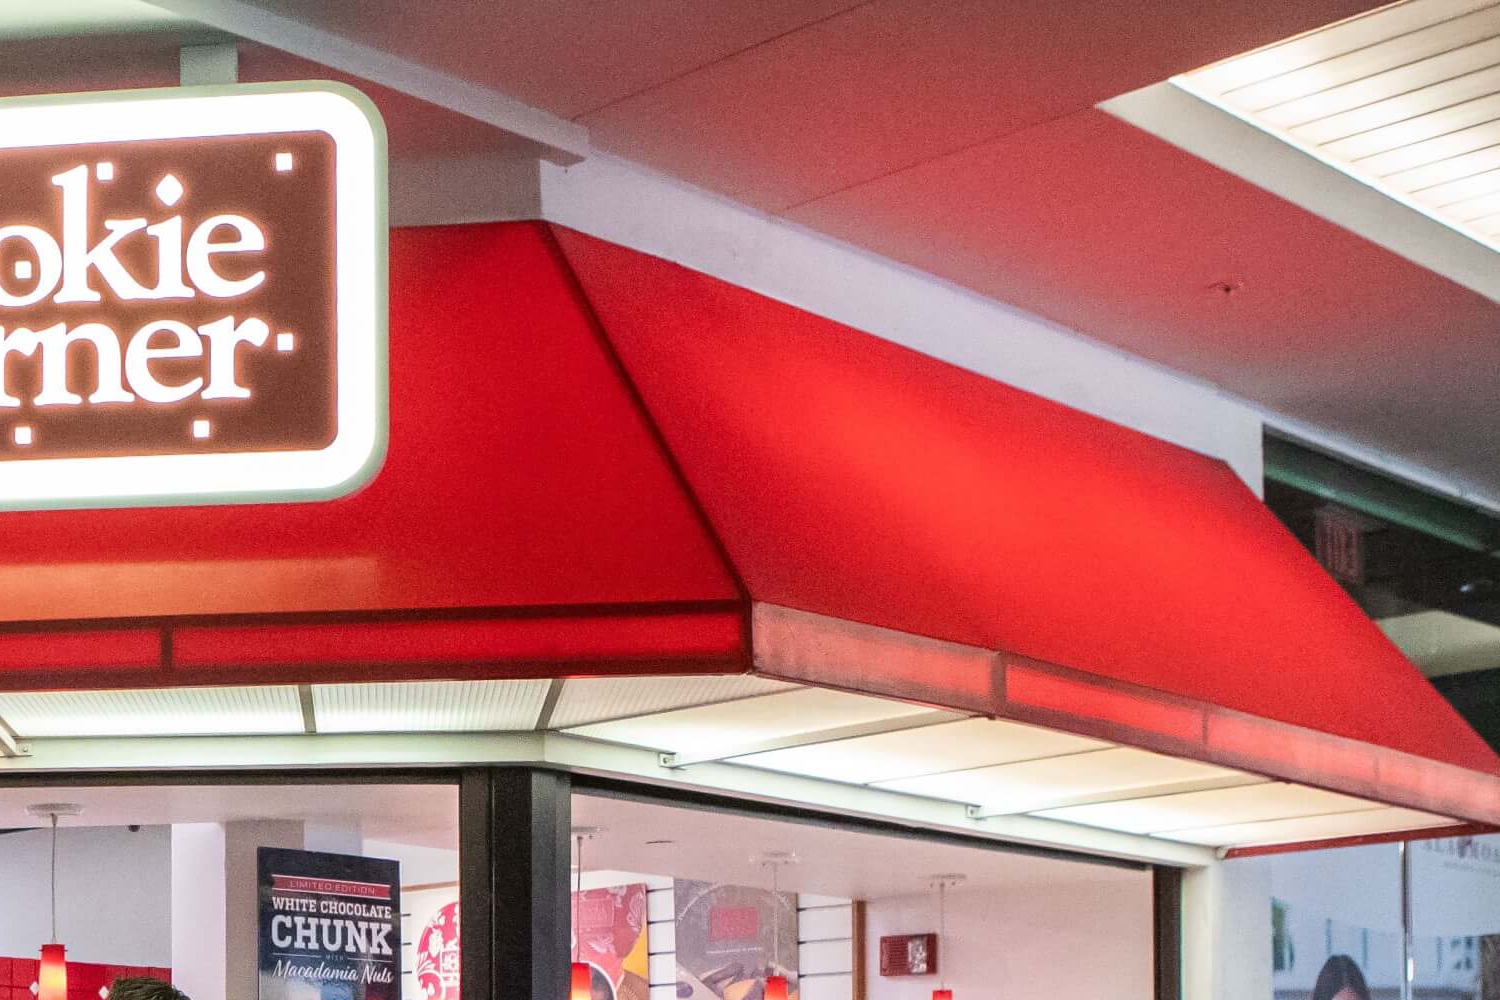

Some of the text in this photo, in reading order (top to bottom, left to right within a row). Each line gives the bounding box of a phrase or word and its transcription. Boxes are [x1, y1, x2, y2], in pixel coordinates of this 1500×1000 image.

[290, 880, 375, 895] LIMITED EDITION
[271, 896, 392, 919] WHITE CHOCOLATE
[271, 914, 393, 955] CHUNK
[272, 959, 394, 985] Macadamia Nuts
